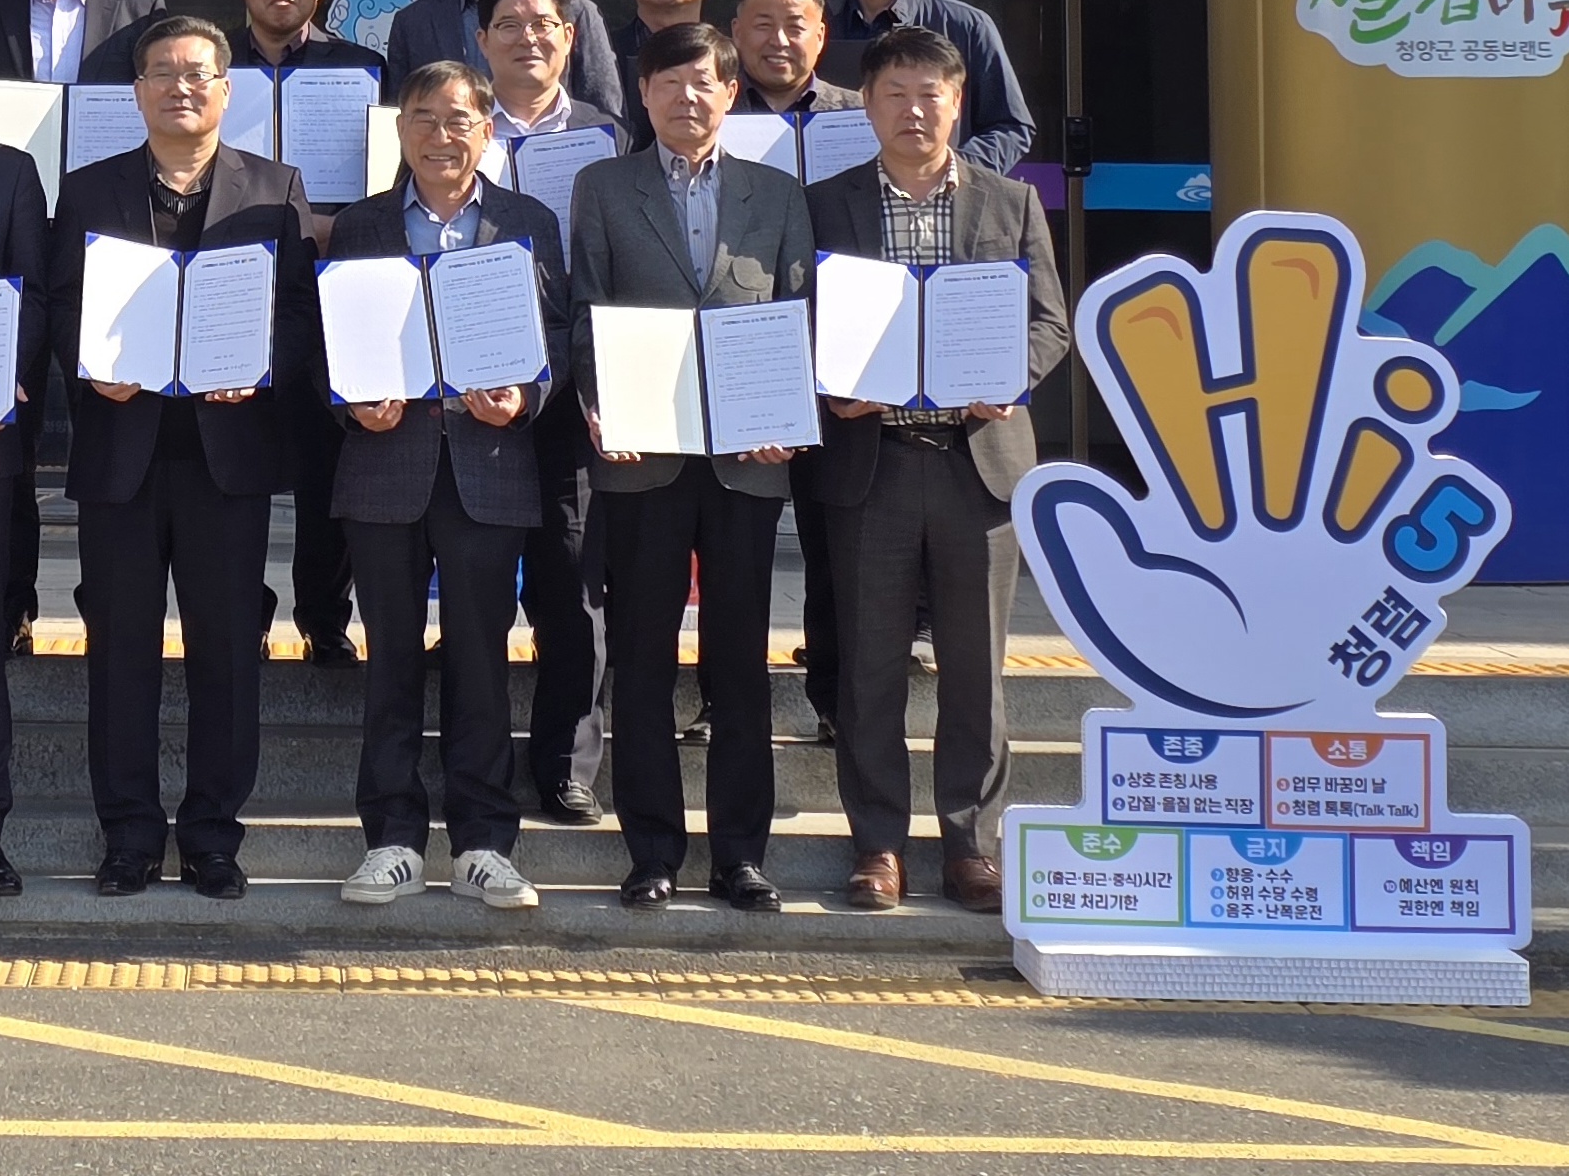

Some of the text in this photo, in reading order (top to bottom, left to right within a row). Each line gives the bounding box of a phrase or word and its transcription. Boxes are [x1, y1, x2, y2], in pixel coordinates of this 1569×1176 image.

[1396, 40, 1553, 62] 청양군 공동브랜드
[1327, 585, 1431, 687] 청렴
[1163, 735, 1204, 758] 존중
[1328, 740, 1368, 761] 소통
[1128, 772, 1156, 789] 상호
[1158, 773, 1187, 790] 존칭
[1189, 774, 1218, 791] 사용
[1292, 776, 1321, 793] 업무
[1324, 777, 1368, 793] 바꿈의
[1372, 777, 1387, 794] 날
[1194, 797, 1222, 814] 없는
[1225, 798, 1255, 815] 직장
[1292, 799, 1321, 817] 청렴
[1082, 833, 1122, 854] 준수
[1246, 837, 1287, 859] 금지
[1411, 840, 1451, 862] 책임
[1226, 885, 1254, 901] 허위
[1258, 886, 1286, 902] 수당
[1291, 886, 1319, 903] 수령
[1399, 878, 1444, 895] 예산엔
[1450, 879, 1479, 895] 원칙
[1048, 892, 1076, 910] 민원
[1399, 900, 1480, 917] 권한엔 책임
